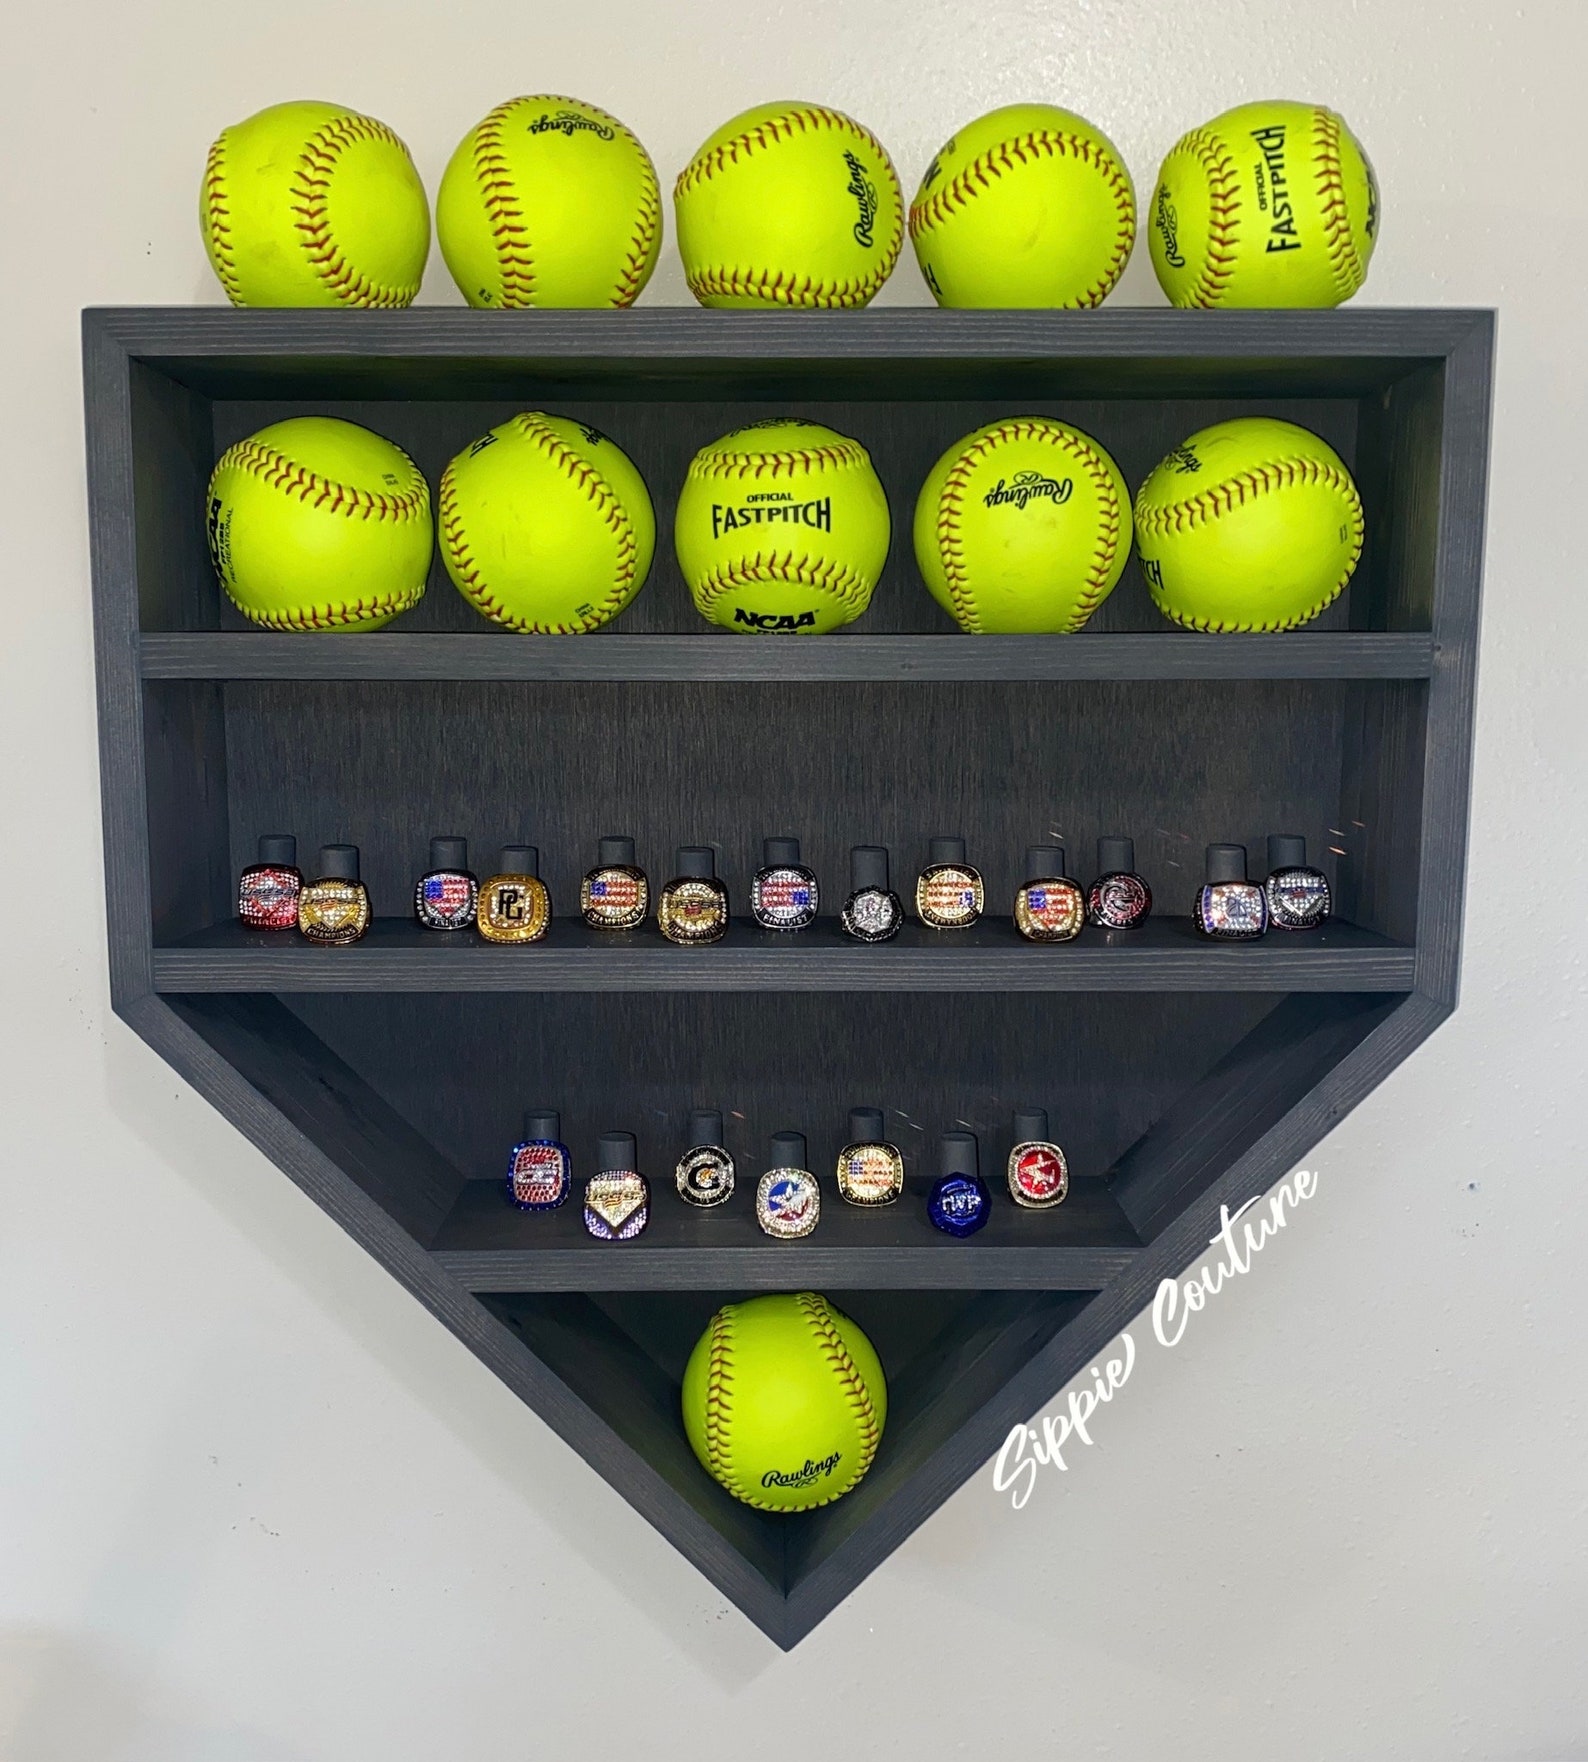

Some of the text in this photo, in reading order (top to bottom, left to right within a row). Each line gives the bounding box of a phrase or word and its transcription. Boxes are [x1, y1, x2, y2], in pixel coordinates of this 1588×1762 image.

[527, 112, 615, 142] Rawlings
[843, 149, 875, 249] Rawlings
[1250, 125, 1302, 253] FASTPITCH
[1254, 162, 1268, 211] OFFICIAL
[1155, 183, 1186, 268] Rawlings
[746, 492, 794, 503] OFFICIAL
[983, 478, 1073, 510] Rawlings
[711, 496, 831, 540] FASTPITCH
[734, 608, 817, 630] NCAA
[306, 927, 356, 939] CHAMPIONS
[587, 911, 640, 925] CHAMPIONS
[762, 913, 808, 926] FINALIST
[761, 1451, 842, 1488] Rawlings
